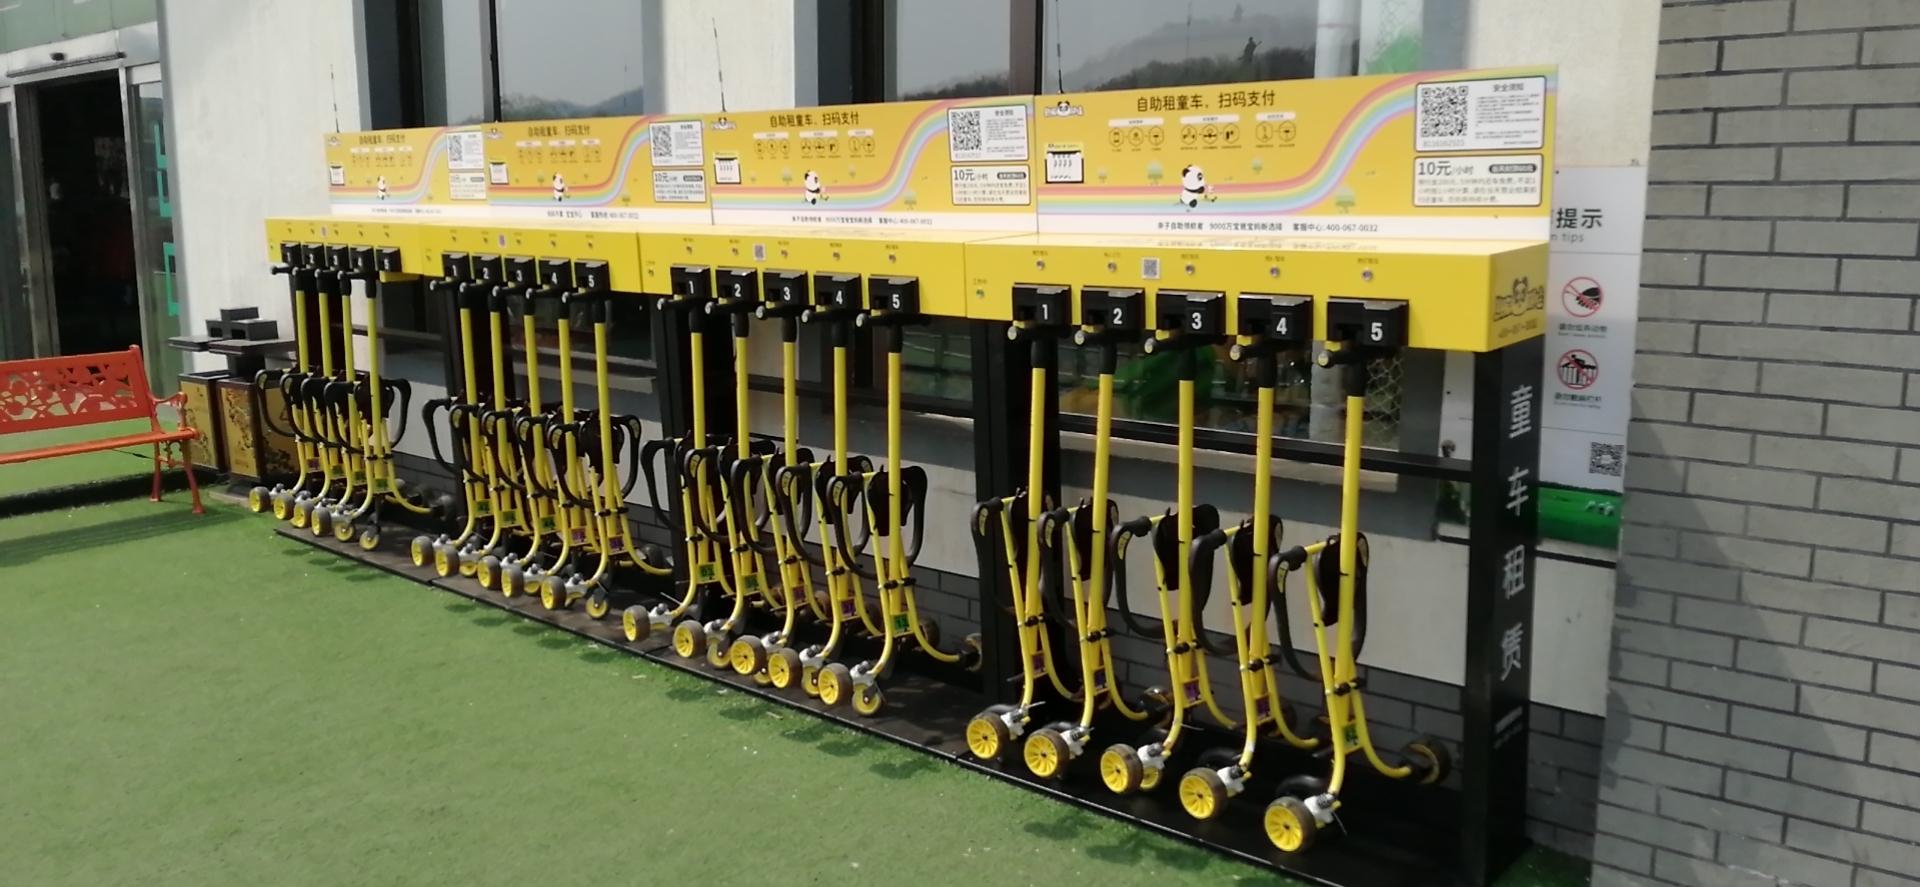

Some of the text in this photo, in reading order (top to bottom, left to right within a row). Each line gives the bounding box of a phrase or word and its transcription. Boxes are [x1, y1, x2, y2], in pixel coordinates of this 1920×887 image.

[1552, 207, 1603, 229] 提示
[1562, 233, 1585, 244] tips
[688, 280, 694, 294] 1
[734, 283, 742, 298] 2
[783, 286, 791, 301] 3
[835, 290, 843, 305] 4
[892, 293, 900, 309] 5
[1042, 304, 1048, 320] 1
[1113, 307, 1123, 325] 2
[1191, 312, 1202, 330] 3
[1276, 317, 1288, 335] 4
[1370, 322, 1383, 342] 5
